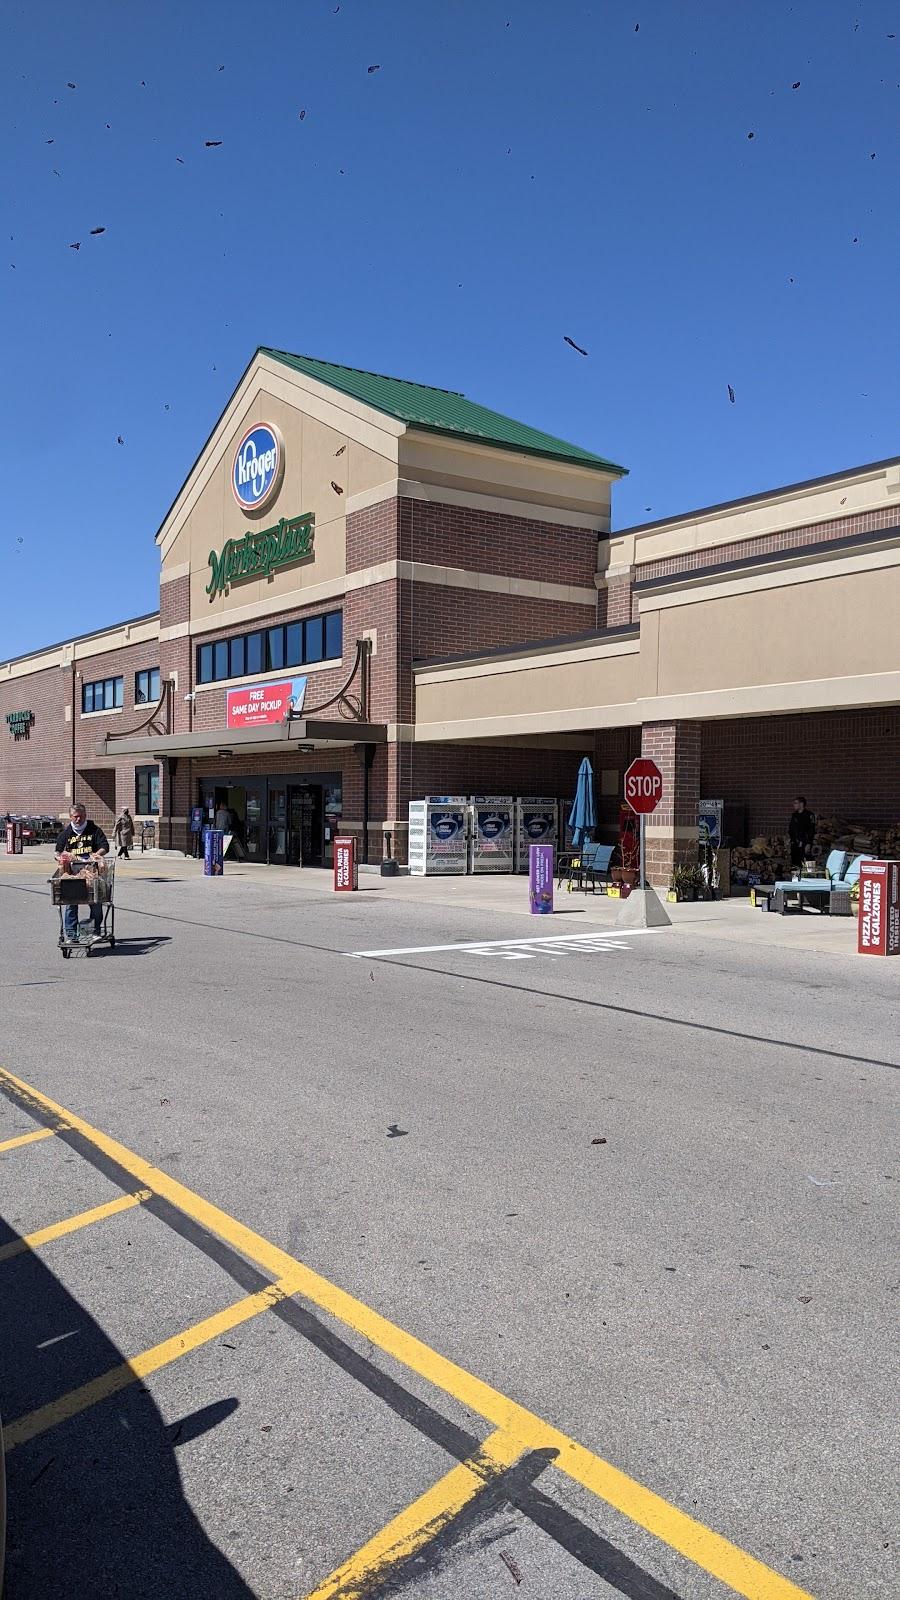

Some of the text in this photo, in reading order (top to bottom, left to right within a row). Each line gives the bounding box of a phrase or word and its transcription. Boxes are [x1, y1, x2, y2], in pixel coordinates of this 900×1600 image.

[239, 441, 275, 496] Kroger
[206, 516, 314, 594] Marketplace
[232, 699, 282, 715] SAME DAY PICKUP
[250, 690, 264, 701] FREE
[628, 776, 661, 797] STOP
[863, 880, 872, 946] PIZZA, PASTA
[872, 883, 881, 945] & CALZONES
